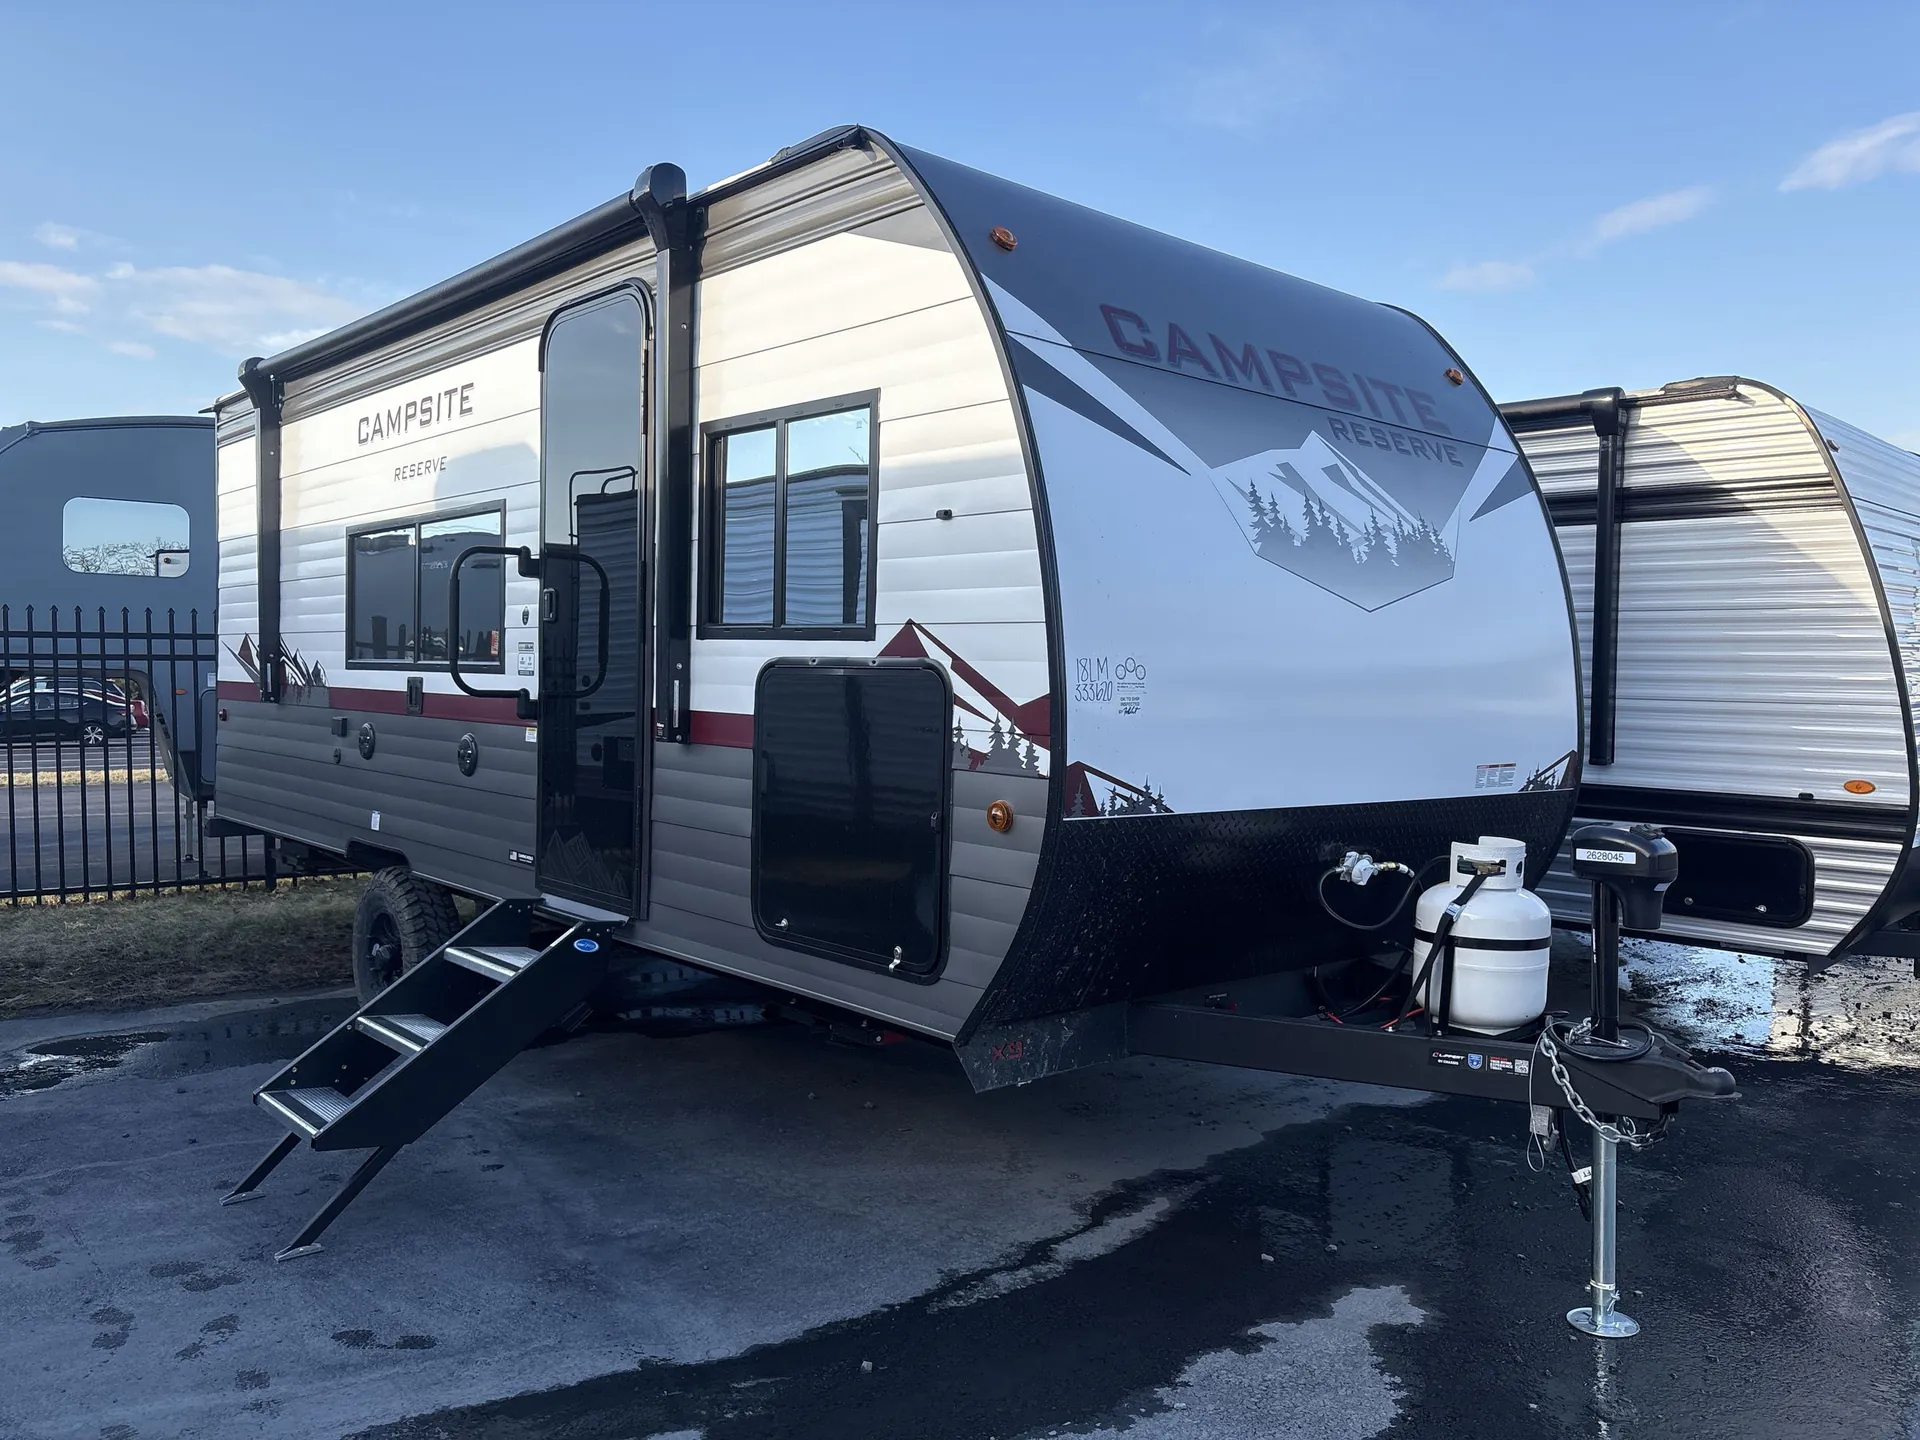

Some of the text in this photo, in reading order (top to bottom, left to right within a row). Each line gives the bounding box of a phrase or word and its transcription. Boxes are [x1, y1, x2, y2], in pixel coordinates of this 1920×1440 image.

[1100, 303, 1452, 435] CAMPSITE
[358, 382, 474, 445] CAMPSITE
[1327, 416, 1464, 467] RESERVE
[394, 456, 447, 481] RESERVE
[1076, 656, 1108, 683] 18LM
[1586, 850, 1624, 862] 2628045
